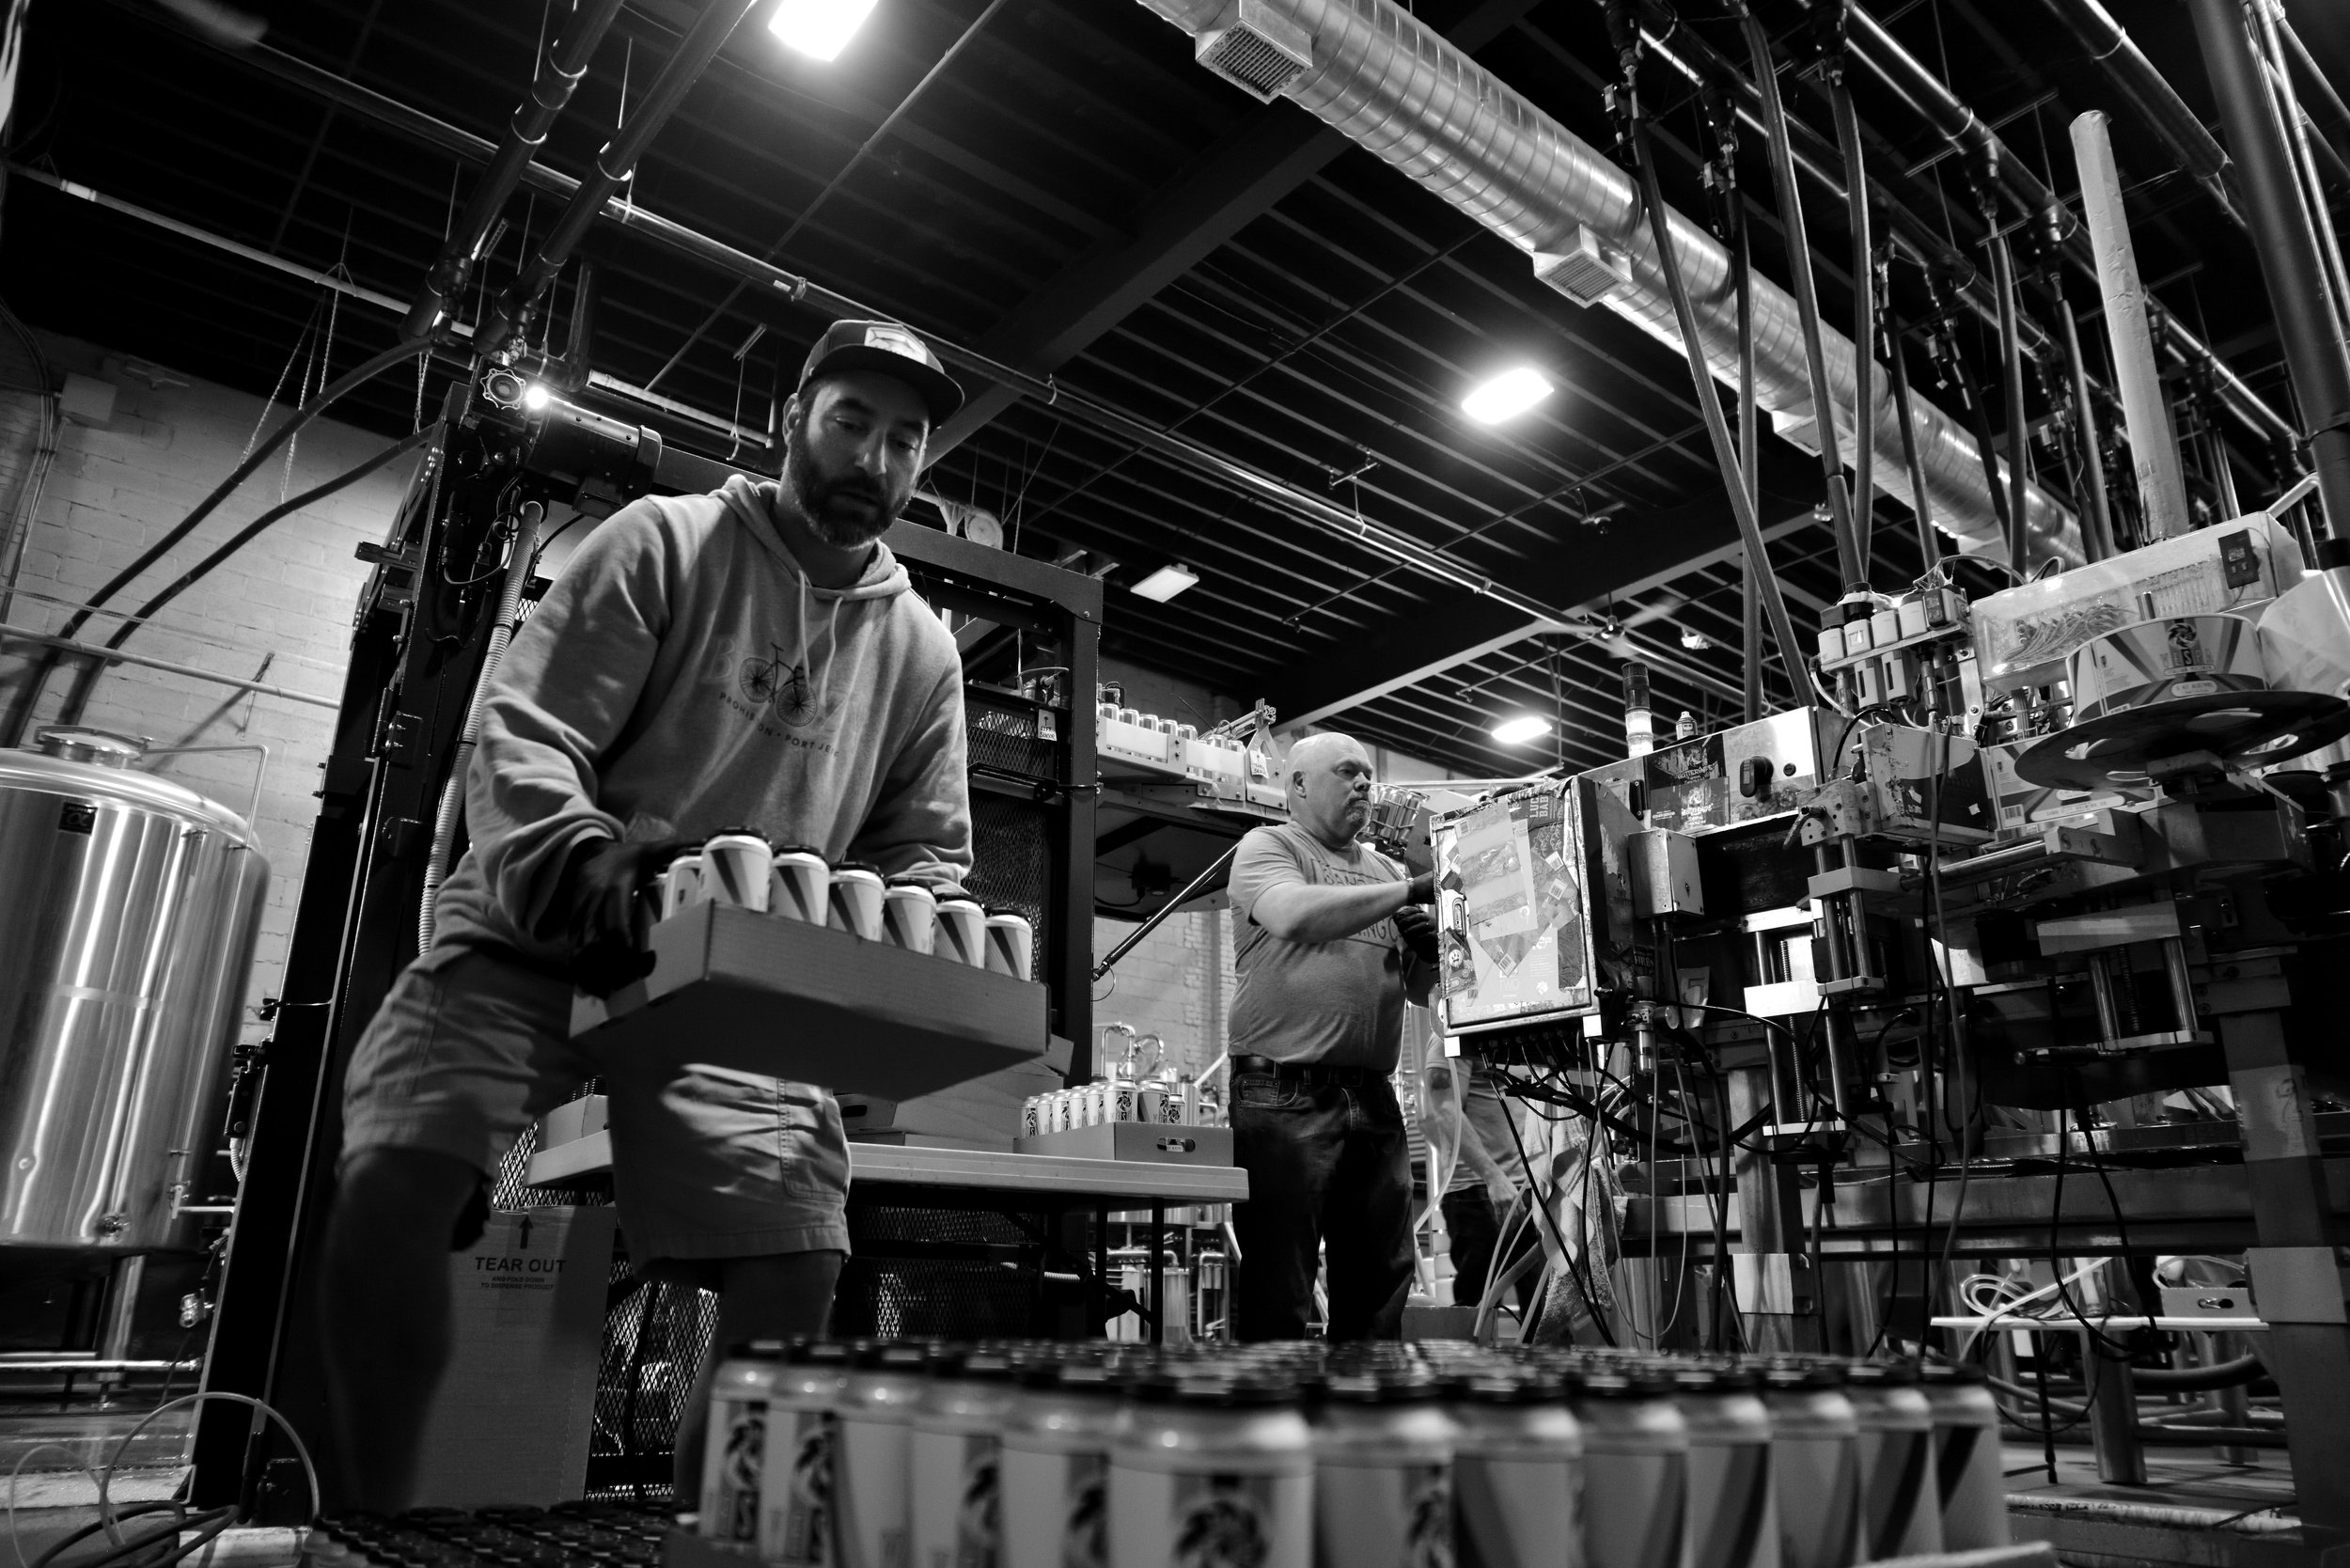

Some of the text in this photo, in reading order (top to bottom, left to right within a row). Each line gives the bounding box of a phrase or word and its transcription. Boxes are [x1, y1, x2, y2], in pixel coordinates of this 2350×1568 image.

[784, 733, 815, 749] PORT
[1497, 979, 1520, 989] TWO
[475, 1257, 567, 1274] TEAR OUT
